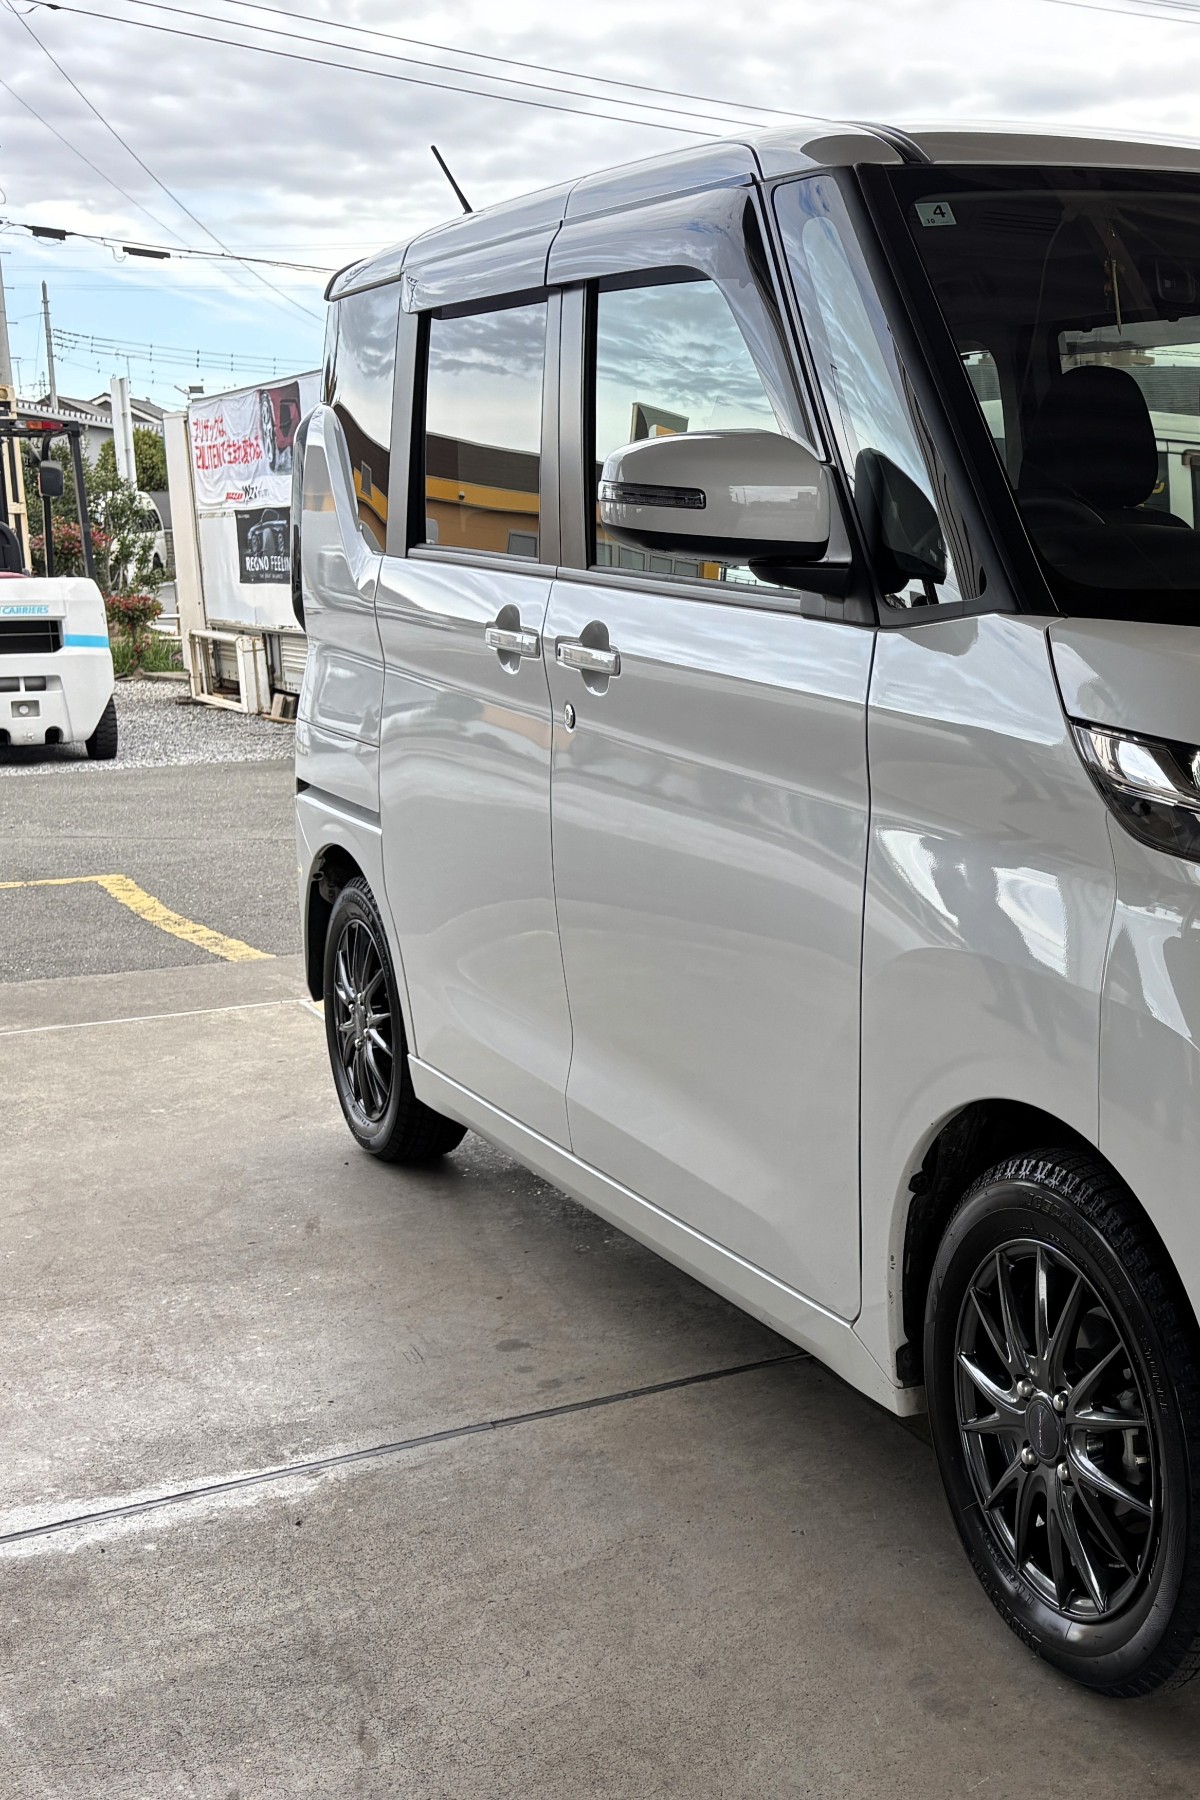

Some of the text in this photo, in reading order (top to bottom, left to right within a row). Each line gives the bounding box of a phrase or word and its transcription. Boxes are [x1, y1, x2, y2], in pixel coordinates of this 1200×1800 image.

[932, 204, 947, 219] 4
[926, 217, 936, 225] 10
[245, 556, 269, 572] REGNO
[0, 604, 49, 615] CARRIERS
